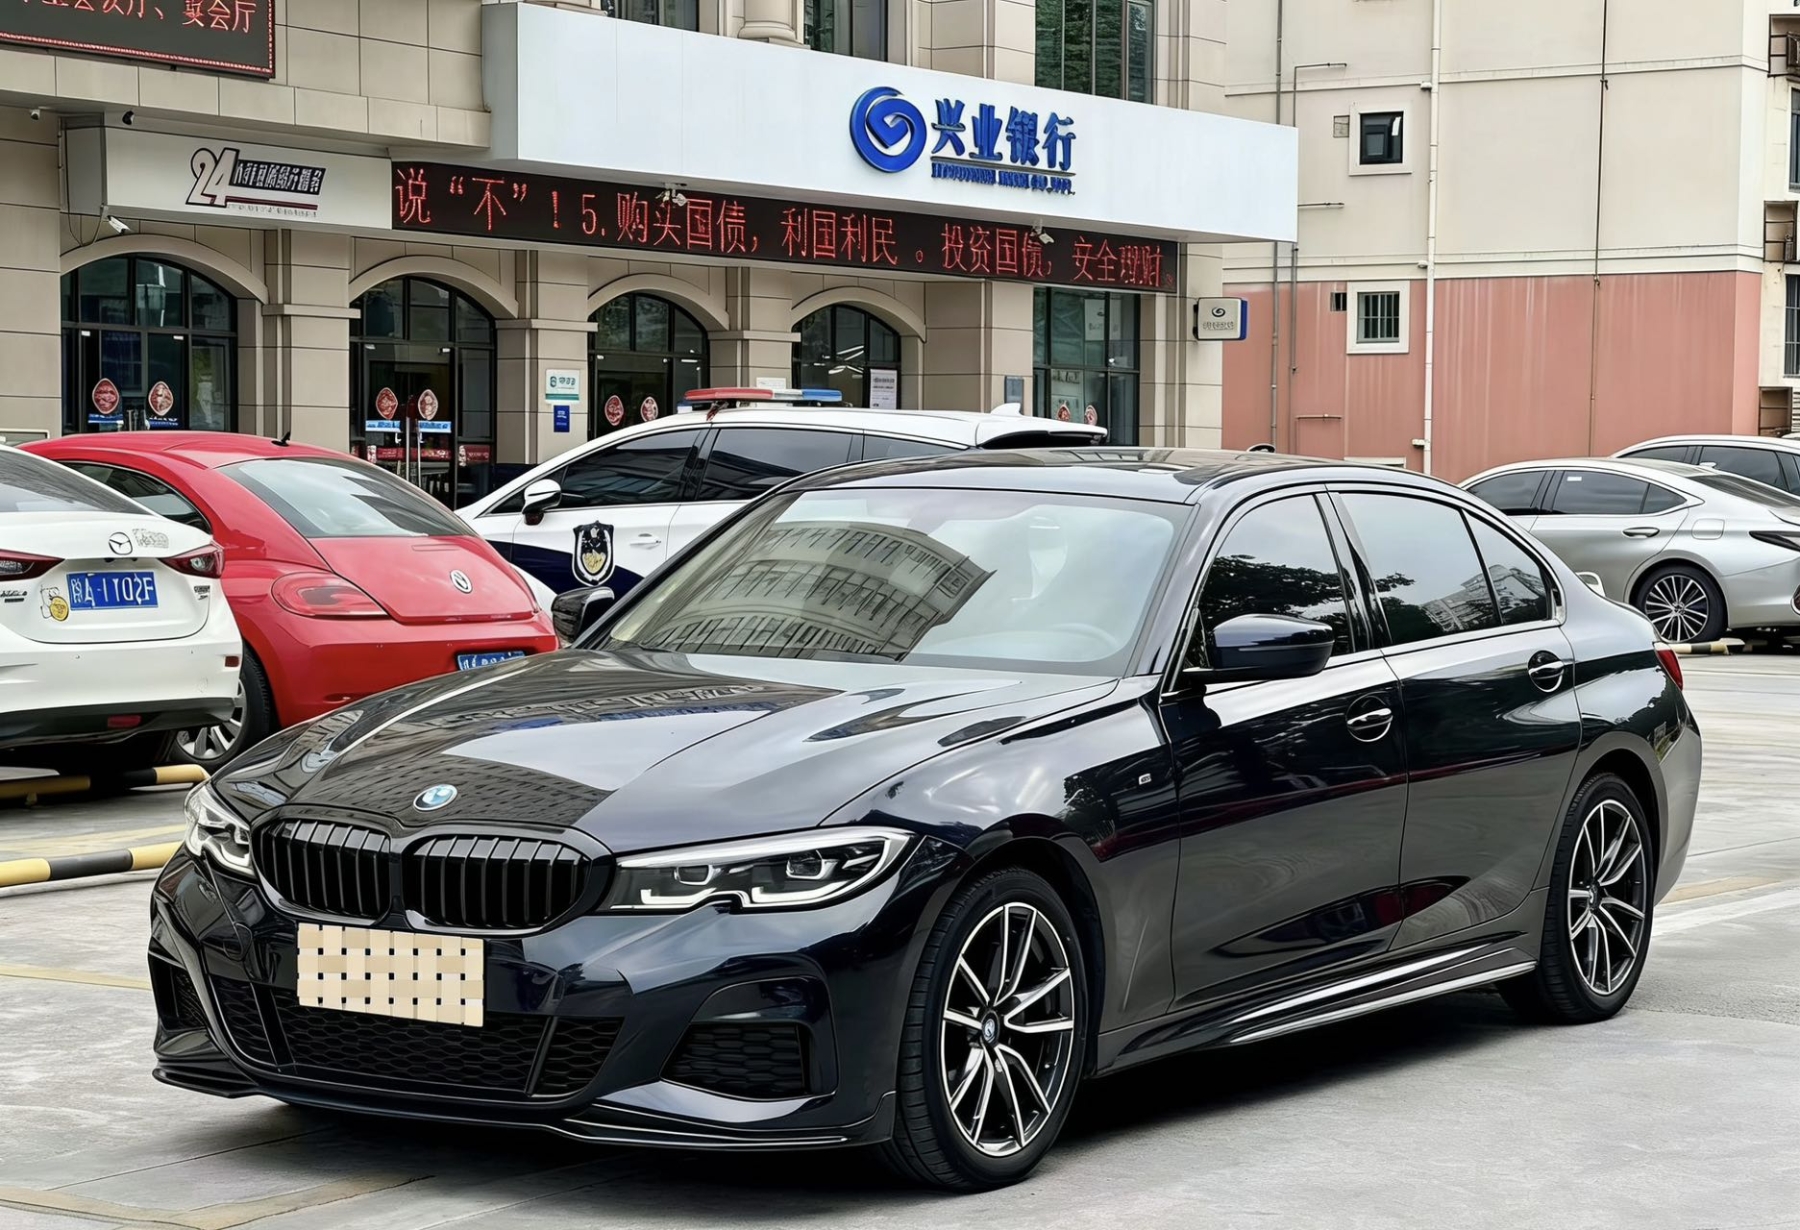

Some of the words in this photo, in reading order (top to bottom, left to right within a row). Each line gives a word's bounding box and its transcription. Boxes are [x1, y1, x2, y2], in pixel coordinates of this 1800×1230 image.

[931, 98, 1077, 171] 兴业银行
[185, 147, 240, 208] 24
